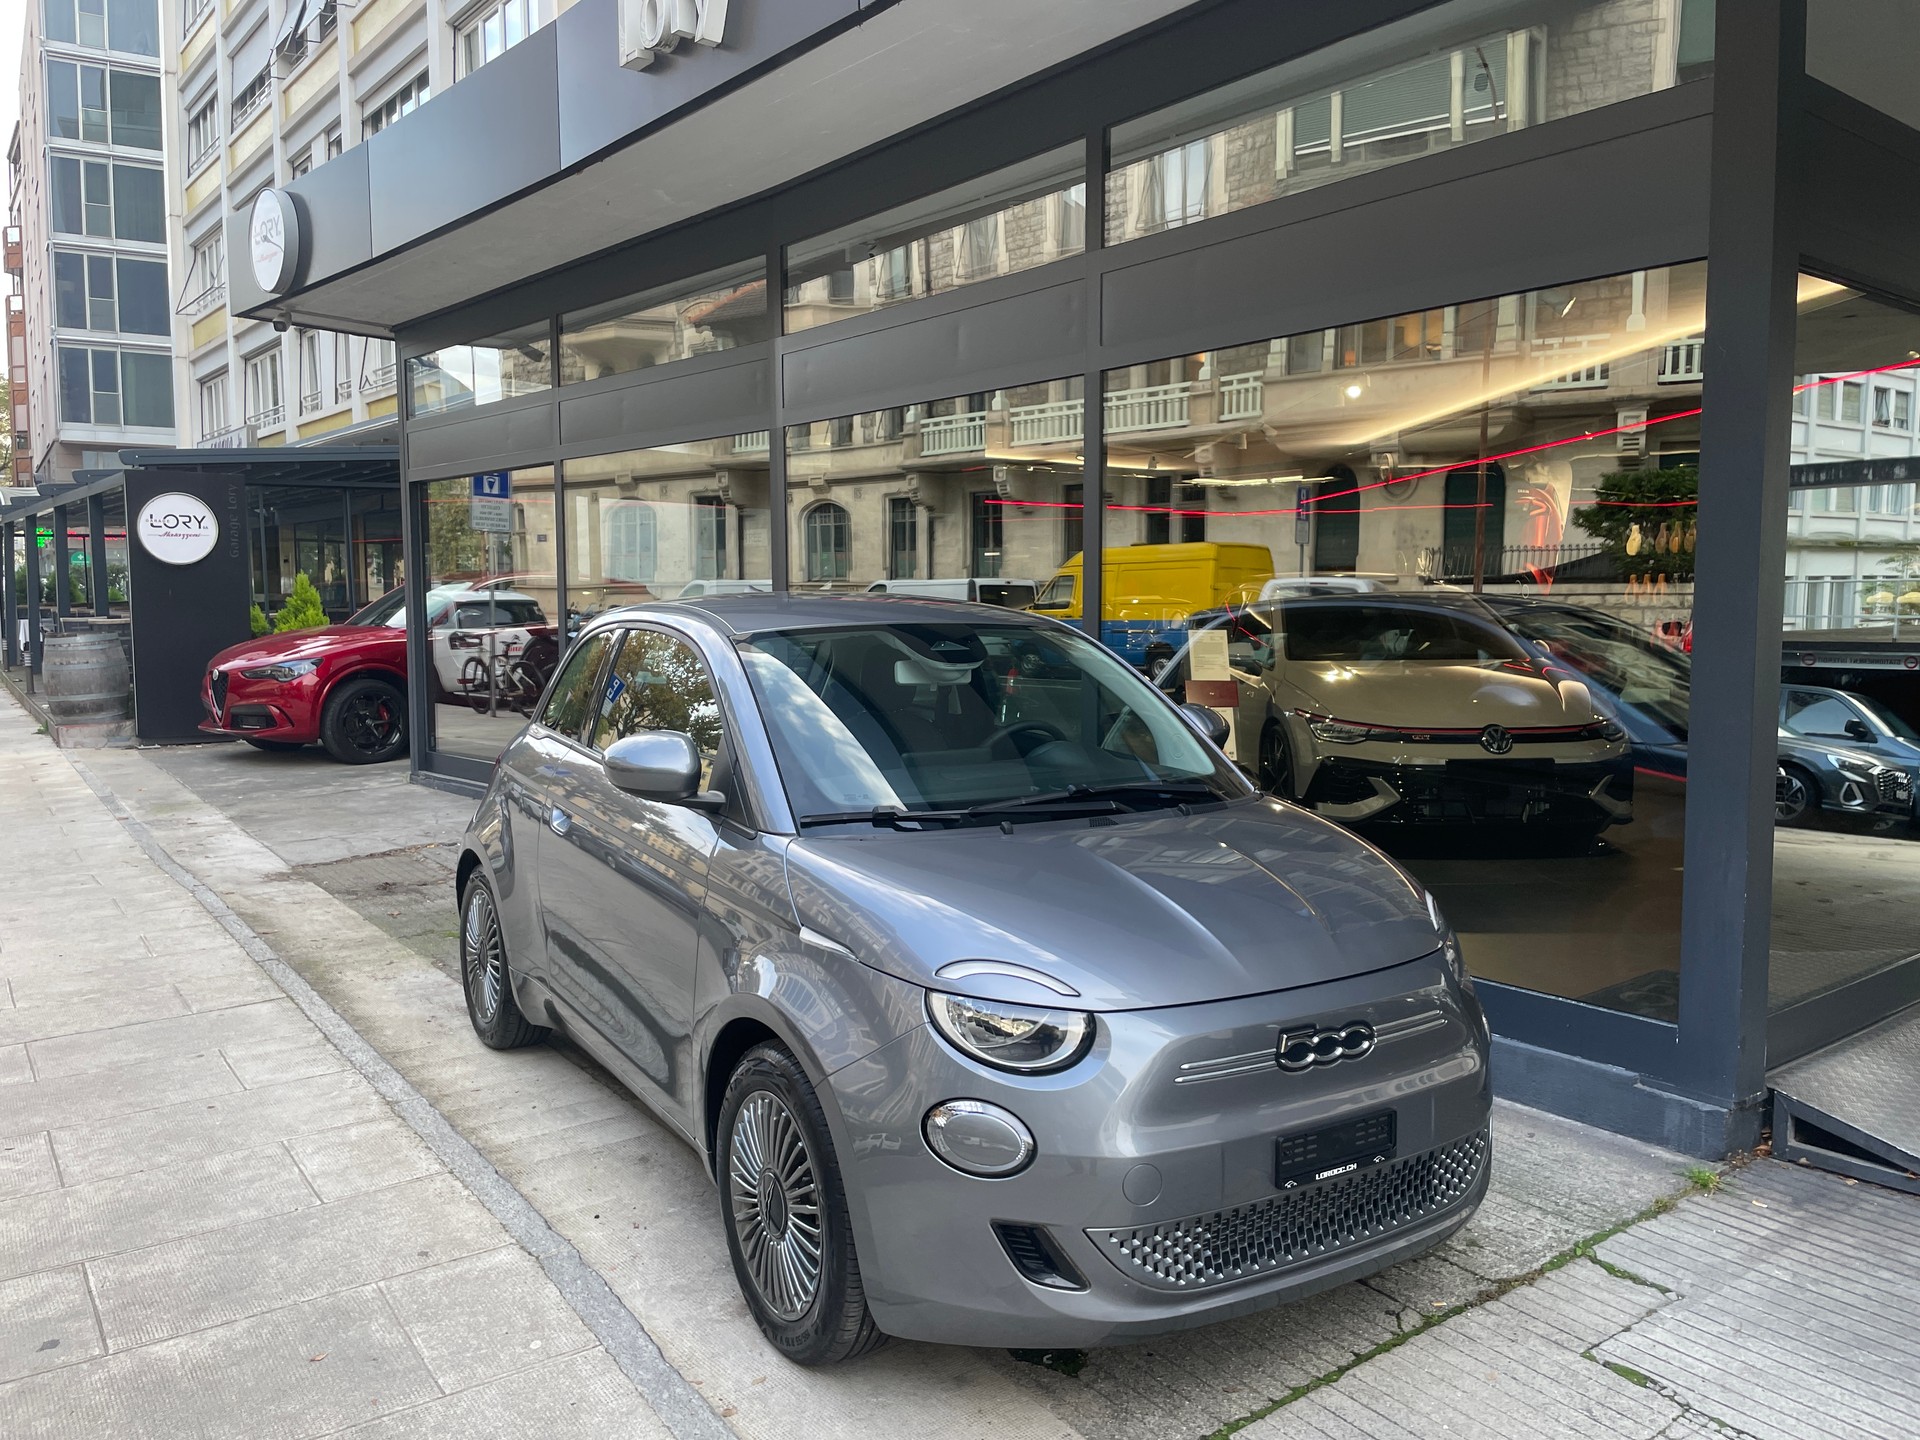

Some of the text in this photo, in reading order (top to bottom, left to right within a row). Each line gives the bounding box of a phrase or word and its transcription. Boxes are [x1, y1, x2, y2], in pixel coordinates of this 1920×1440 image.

[150, 514, 206, 529] LORY
[227, 483, 240, 558] Garage Lory
[1276, 1020, 1377, 1074] 500
